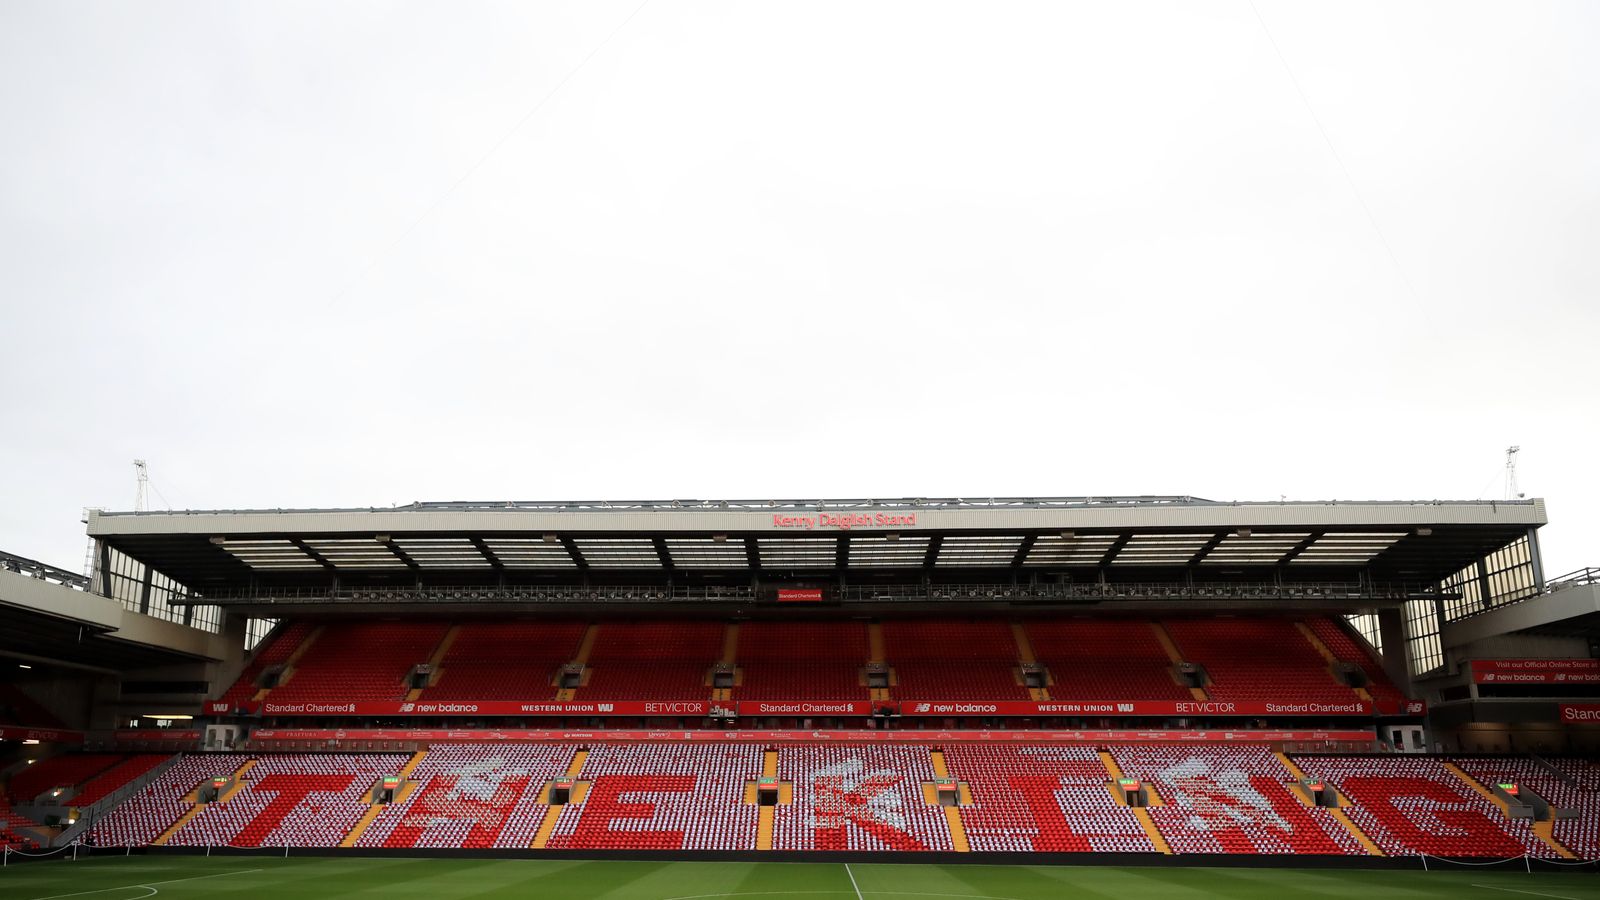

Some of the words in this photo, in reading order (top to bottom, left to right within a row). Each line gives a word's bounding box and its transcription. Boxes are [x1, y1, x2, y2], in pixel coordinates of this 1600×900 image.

[773, 513, 816, 529] Kenny
[819, 513, 873, 529] Dalglish
[875, 512, 916, 526] Stand
[1513, 673, 1545, 681] balance
[265, 703, 304, 712] Standard
[305, 703, 348, 712] Chartered
[438, 703, 478, 712] balance
[521, 704, 563, 712] WESTERN
[565, 704, 594, 712] UNION
[645, 702, 702, 713] BETVICTOR
[760, 703, 800, 712] Standard
[802, 703, 846, 712] Chartered
[955, 703, 997, 712] balance
[1038, 704, 1081, 712] WESTERN
[1083, 704, 1113, 712] UNION
[1176, 702, 1236, 713] BETVICTOR
[1265, 703, 1308, 712] Standard
[1309, 703, 1355, 712] Chartered
